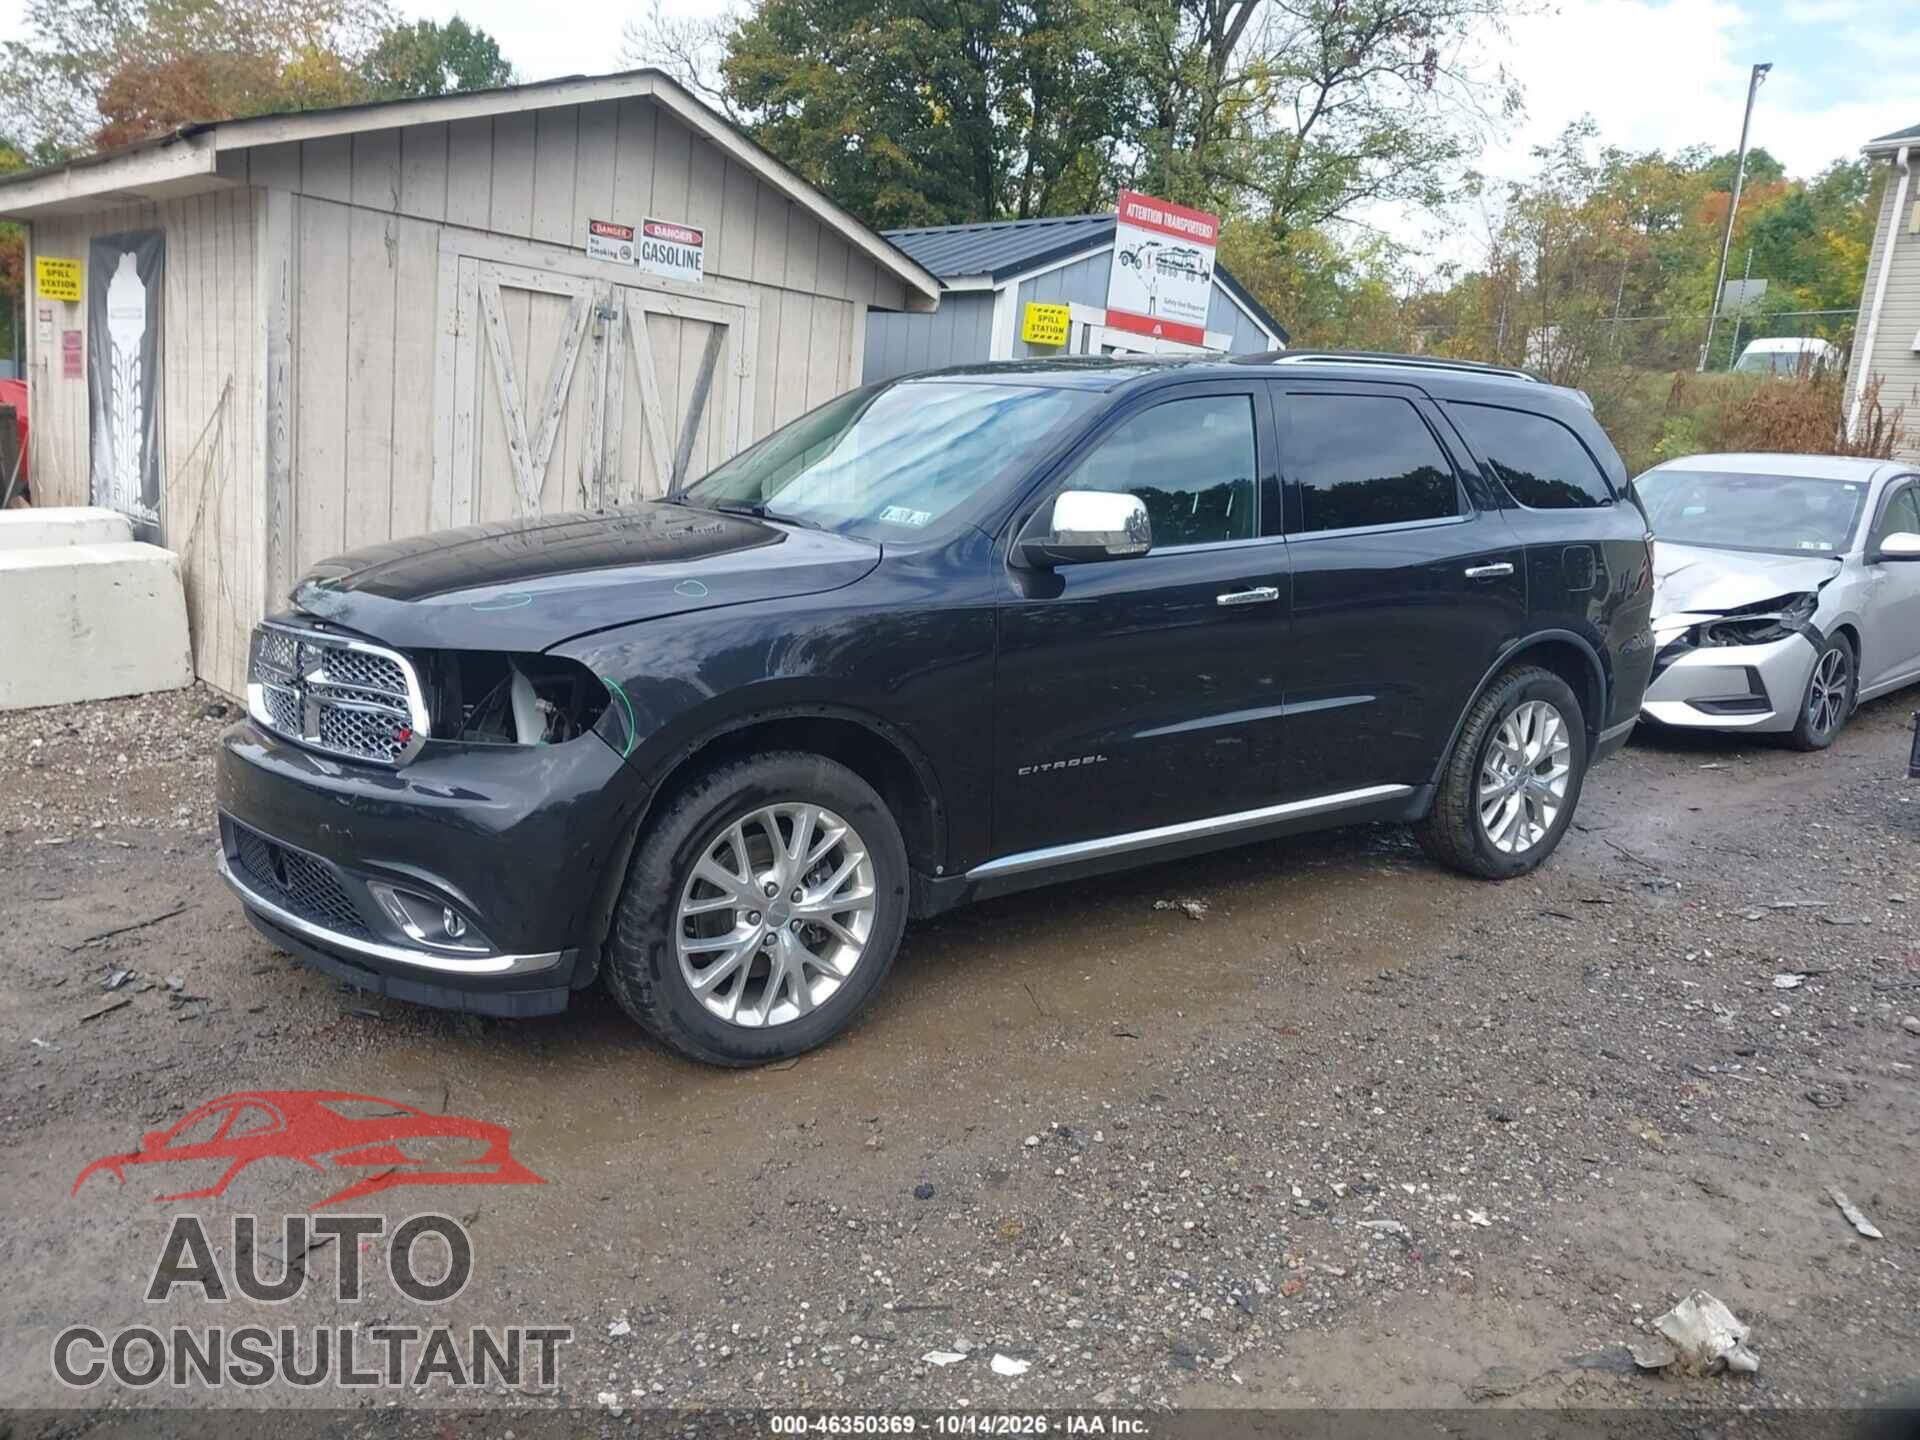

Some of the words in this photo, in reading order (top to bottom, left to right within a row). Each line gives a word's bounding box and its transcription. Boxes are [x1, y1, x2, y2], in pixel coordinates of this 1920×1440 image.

[1126, 203, 1163, 224] ATTENTION
[654, 225, 692, 243] DANGER
[642, 241, 702, 271] GASOLINE
[46, 268, 70, 279] SPILL
[40, 278, 77, 289] STATION
[1038, 314, 1060, 325] SPILL
[1031, 324, 1064, 334] STATION
[1018, 755, 1107, 775] CITADEL
